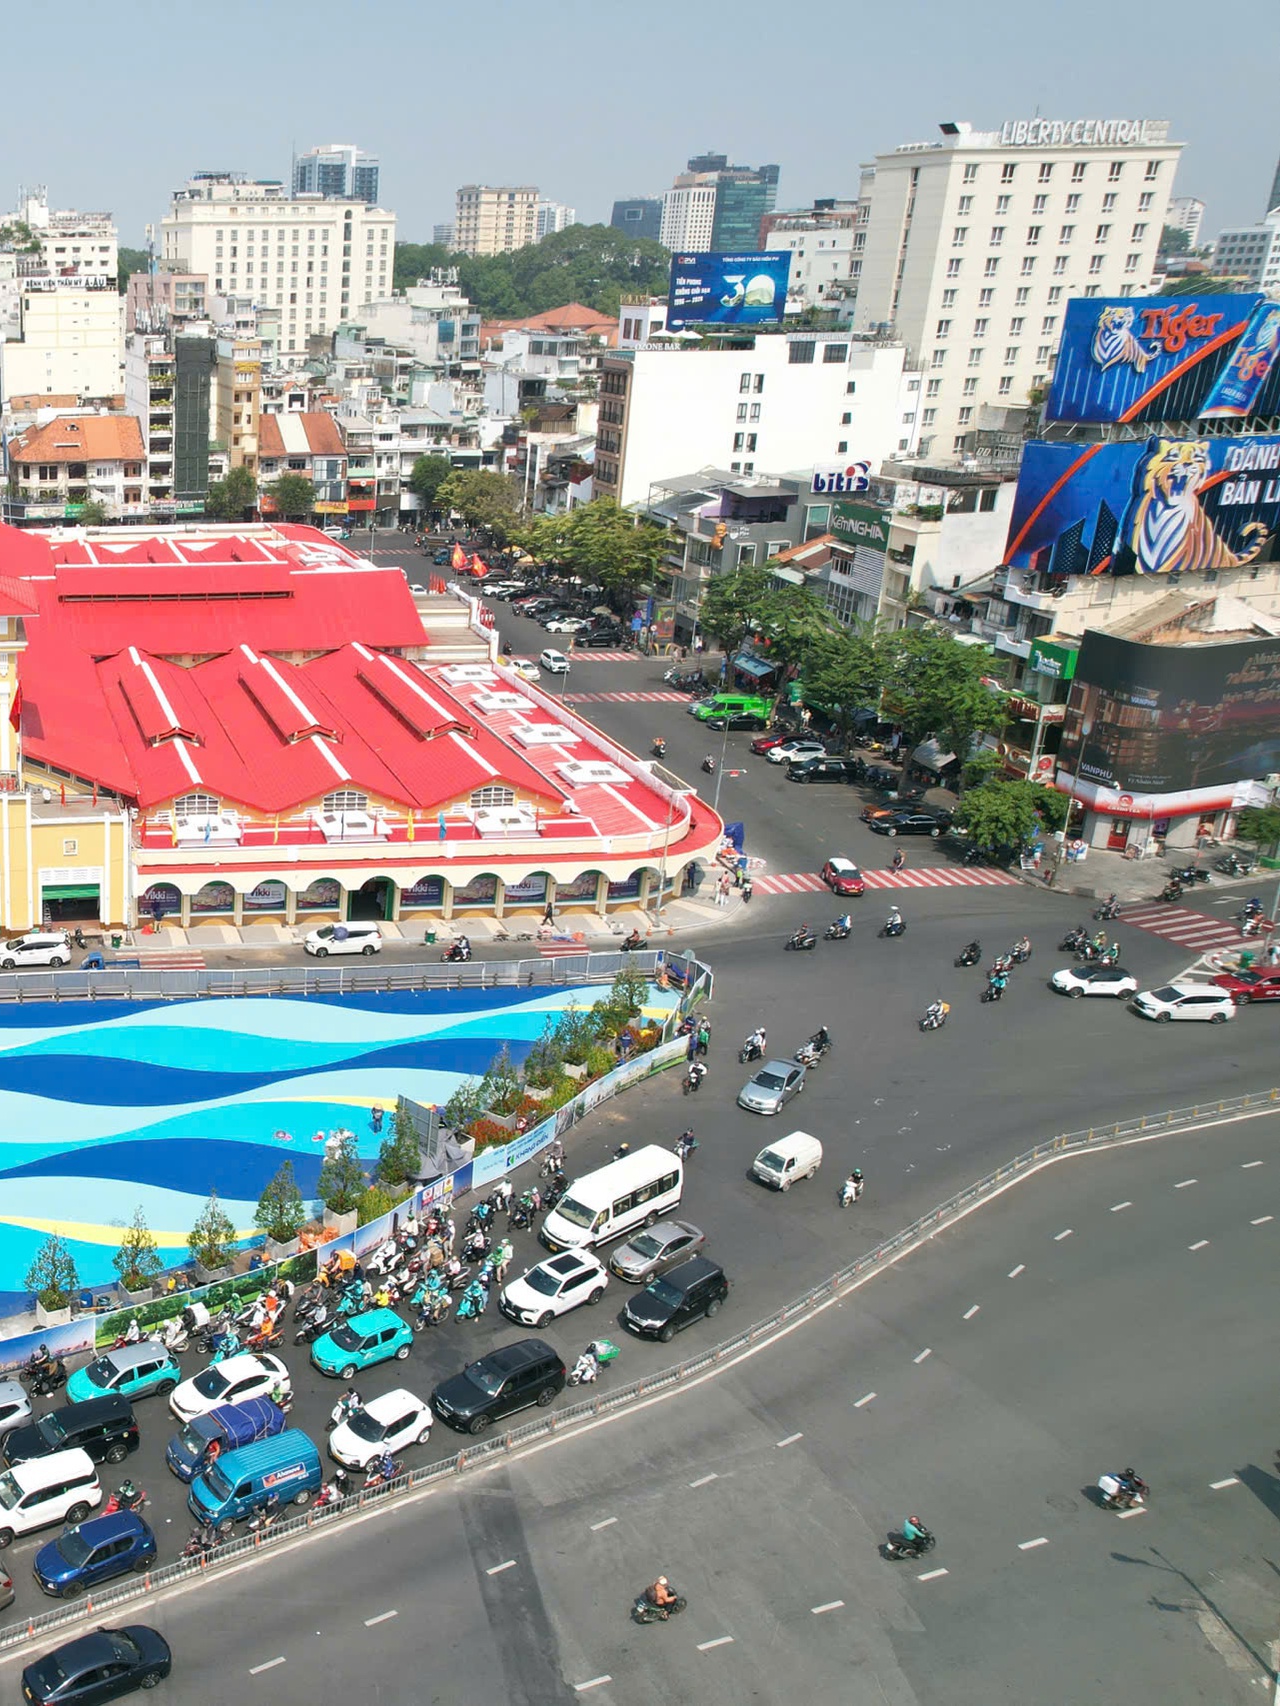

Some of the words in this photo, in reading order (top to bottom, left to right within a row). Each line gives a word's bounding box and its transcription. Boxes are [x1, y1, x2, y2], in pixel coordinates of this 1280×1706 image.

[1001, 119, 1071, 145] LIBERTY
[1072, 119, 1148, 144] CENTRAL
[1141, 303, 1224, 352] Tiger
[144, 887, 166, 900] Vikki
